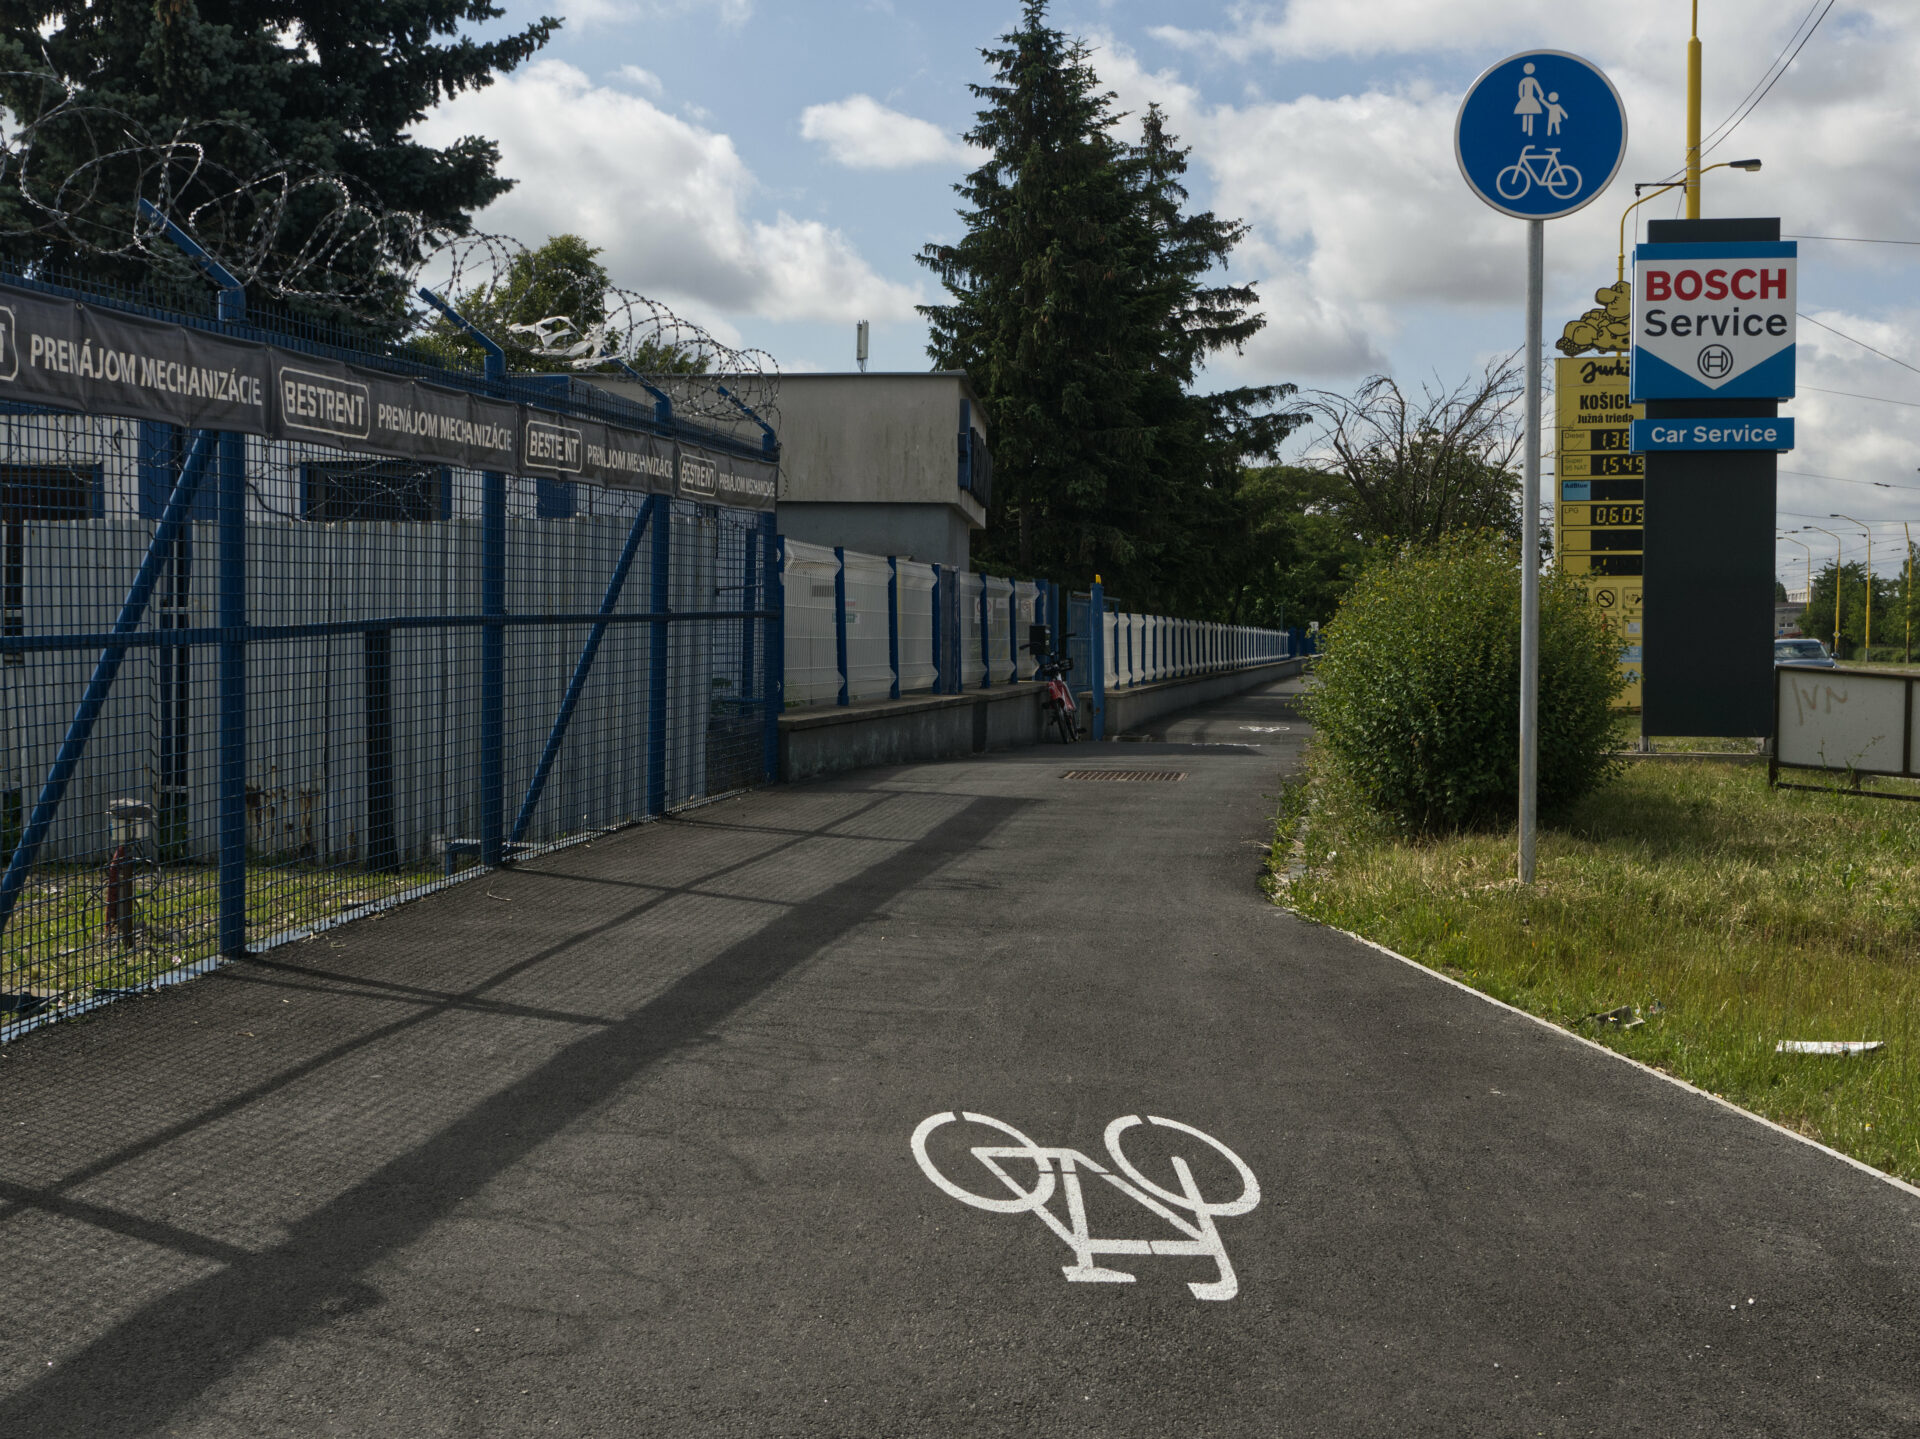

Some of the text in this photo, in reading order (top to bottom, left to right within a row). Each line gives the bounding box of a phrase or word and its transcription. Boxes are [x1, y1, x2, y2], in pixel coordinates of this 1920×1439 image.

[1646, 268, 1787, 301] BOSCH
[1644, 307, 1788, 337] Service
[30, 333, 136, 385] PRENÁJOM
[141, 357, 262, 406] MECHANIZÁCIE
[285, 380, 512, 451] BESTRENT PRENÁJOM MECHANIZÁCIE
[1651, 424, 1777, 443] Car Service
[529, 430, 580, 464] BESTENT
[587, 444, 626, 470] PRENJOM
